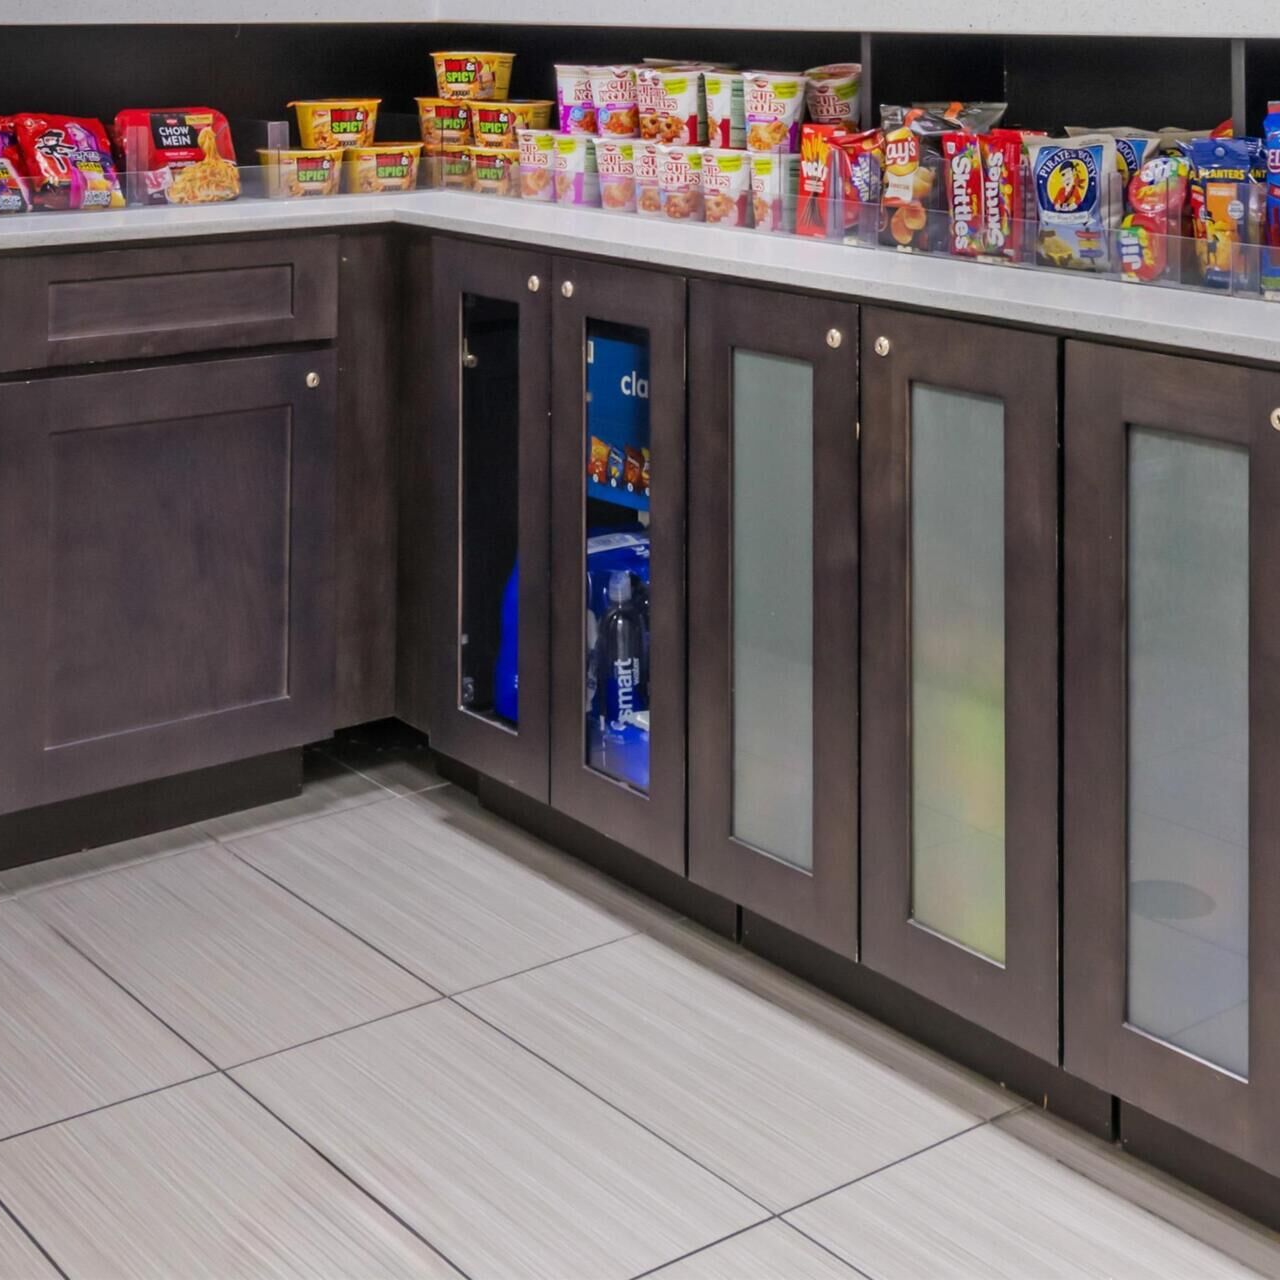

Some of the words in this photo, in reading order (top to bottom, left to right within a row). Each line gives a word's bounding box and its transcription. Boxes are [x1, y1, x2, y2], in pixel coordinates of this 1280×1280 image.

[446, 72, 475, 83] SPICY
[159, 125, 190, 137] CHOW
[332, 121, 363, 133] SPICY
[479, 123, 508, 134] SPICY
[161, 134, 191, 147] MEIN
[951, 155, 972, 250] Skittles
[615, 658, 632, 717] smart
